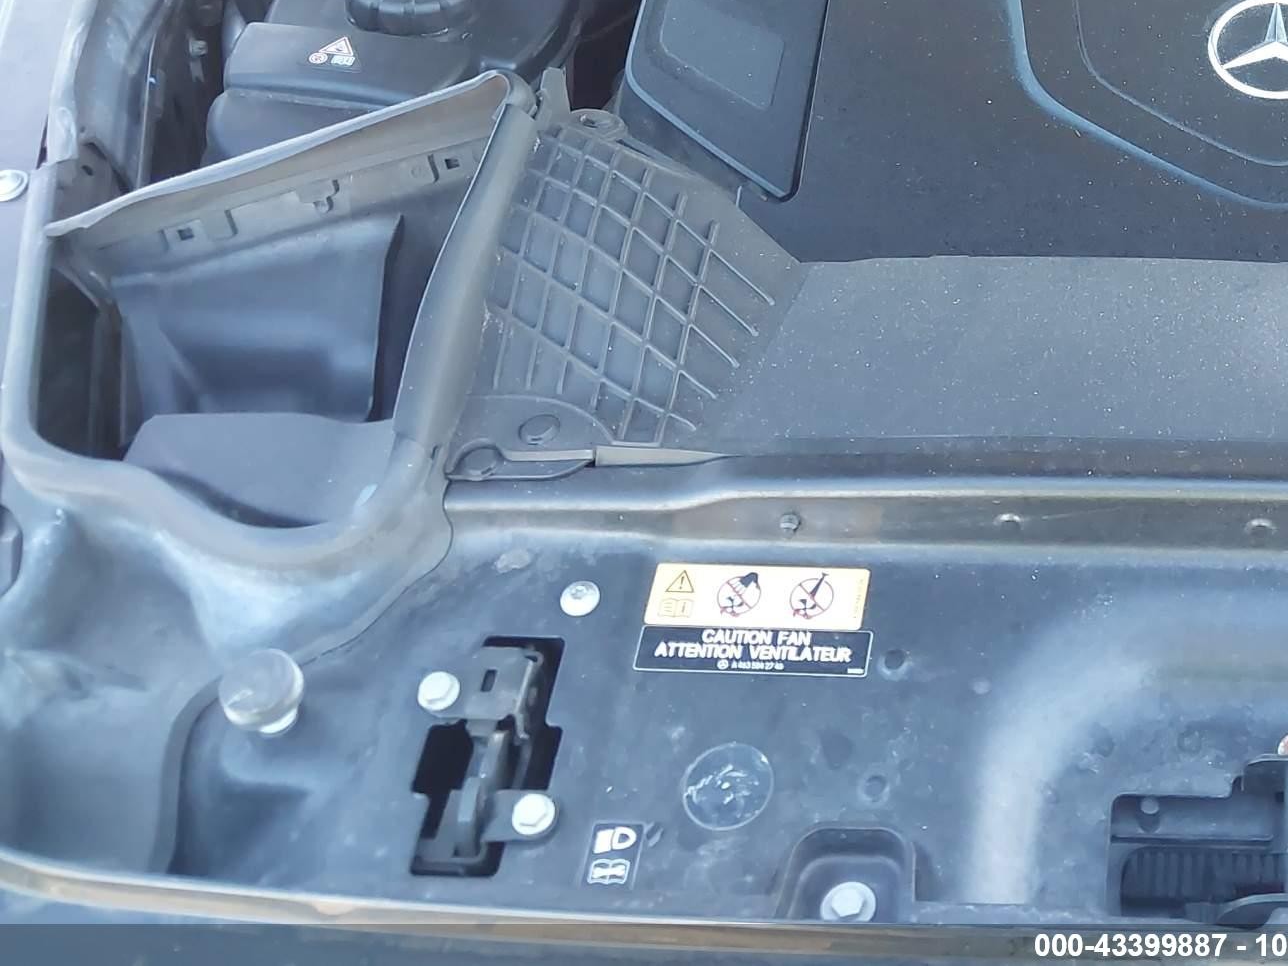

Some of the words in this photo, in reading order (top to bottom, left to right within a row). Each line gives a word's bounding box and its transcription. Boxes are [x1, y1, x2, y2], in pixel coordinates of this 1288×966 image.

[701, 629, 773, 645] CAUTION
[777, 631, 813, 646] FAN
[654, 641, 743, 659] ATTENTION
[749, 645, 852, 662] VENTILATEUR
